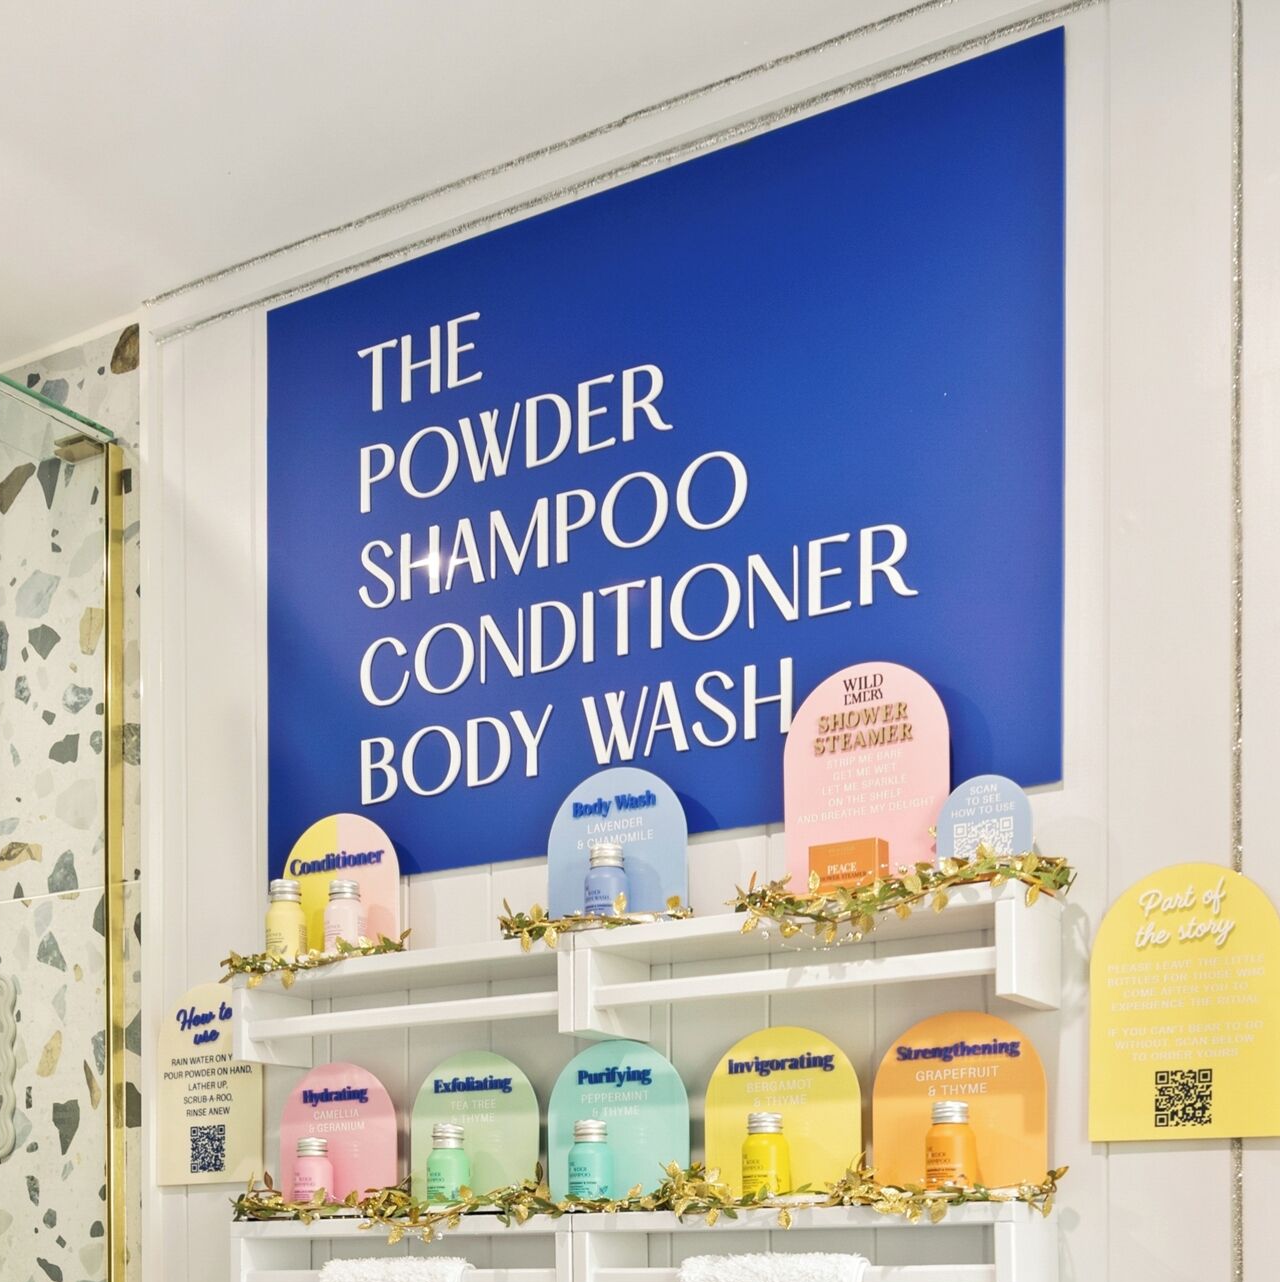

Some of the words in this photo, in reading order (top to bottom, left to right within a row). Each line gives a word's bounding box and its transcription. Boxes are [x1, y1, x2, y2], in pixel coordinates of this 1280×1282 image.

[358, 312, 483, 412] THE
[360, 364, 673, 514] POWDER
[359, 451, 749, 609] SHAMPOO
[360, 523, 919, 707] CONDITIONER
[843, 674, 883, 692] WILD
[844, 688, 883, 706] EMERY
[817, 702, 908, 734] SHOWER
[360, 704, 553, 806] BODY
[582, 658, 793, 765] WASH
[814, 723, 913, 757] STEAMER
[826, 755, 855, 769] STRIP
[858, 753, 873, 764] ME
[876, 749, 904, 761] BARE
[832, 770, 851, 781] GET
[856, 766, 871, 777] ME
[875, 762, 896, 774] WET
[822, 784, 839, 796] LET
[844, 781, 858, 793] ME
[862, 774, 908, 789] SPARKLE
[969, 783, 997, 796] SCAN
[572, 798, 612, 819] Body
[614, 789, 657, 811] Wash
[828, 797, 843, 808] ON
[848, 794, 865, 805] THE
[870, 788, 904, 802] SHELF
[967, 796, 983, 807] TO
[985, 793, 1001, 804] SEE
[797, 813, 819, 825] AND
[821, 807, 866, 822] BREATHE
[870, 804, 886, 815] MY
[888, 796, 935, 811] DELIGHT
[951, 808, 976, 819] HOW
[979, 805, 993, 816] TO
[995, 802, 1016, 813] USE
[587, 816, 643, 834] LAVENDER
[577, 840, 584, 850] &
[289, 848, 385, 877] Conditioner
[827, 861, 857, 875] PEACE
[1138, 885, 1196, 917] Part
[1202, 875, 1226, 914] of
[1135, 921, 1169, 948] the
[1178, 917, 1236, 946] story
[1111, 999, 1185, 1012] EXPERIENCE
[176, 1006, 215, 1031] How
[218, 1001, 233, 1021] to
[193, 1029, 220, 1045] use
[897, 1038, 1020, 1063] Strengthening
[171, 1057, 189, 1066] RAIN
[189, 1055, 214, 1065] WATER
[215, 1054, 227, 1063] ON
[727, 1052, 835, 1077] Invigorating
[164, 1071, 183, 1080] POUR
[184, 1068, 216, 1079] POWDER
[217, 1067, 228, 1076] ON
[230, 1065, 252, 1076] HAND,
[578, 1066, 652, 1087] Purifying
[916, 1065, 1000, 1082] GRAPEFRUIT
[188, 1081, 217, 1091] LATHER
[433, 1074, 512, 1095] Exfoliating
[746, 1078, 813, 1093] BERGAMOT
[928, 1085, 937, 1097] &
[941, 1082, 987, 1096] THYME
[302, 1085, 369, 1108] Hydrating
[450, 1099, 469, 1111] TEA
[472, 1097, 496, 1109] TREE
[581, 1091, 649, 1104] PEPPERMINT
[753, 1097, 763, 1108] &
[766, 1094, 808, 1107] THYME
[186, 1108, 208, 1117] RINSE
[209, 1107, 230, 1116] ANEW
[313, 1108, 359, 1120] CAMELLIA
[461, 1112, 494, 1123] THYME
[592, 1107, 599, 1117] &
[603, 1105, 640, 1116] THYME
[308, 1124, 316, 1134] &
[317, 1121, 365, 1133] GERANIUM
